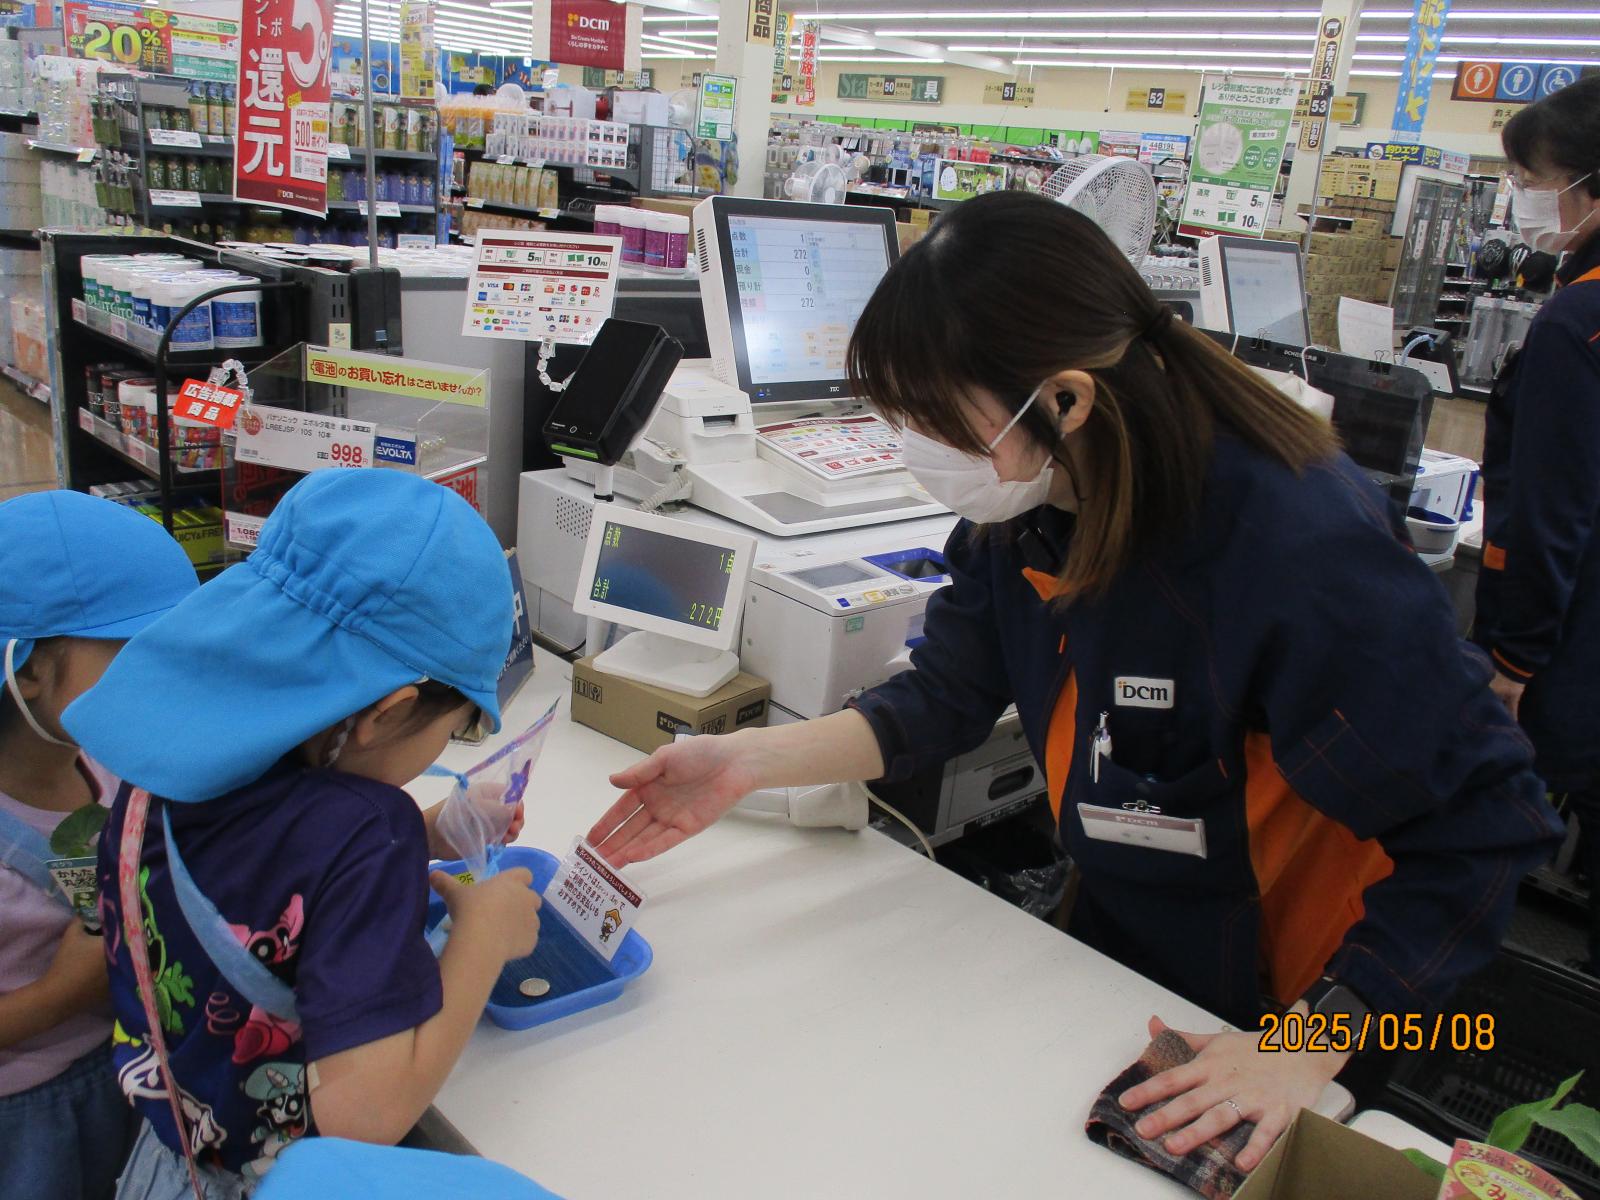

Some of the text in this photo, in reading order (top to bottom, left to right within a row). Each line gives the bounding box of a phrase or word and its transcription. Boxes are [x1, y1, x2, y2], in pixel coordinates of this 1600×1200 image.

[884, 81, 895, 92] 50
[1003, 86, 1015, 98] 51
[1149, 92, 1163, 104] 52
[244, 47, 285, 177] 還元
[1310, 99, 1327, 114] 53
[295, 120, 311, 147] 500
[731, 231, 747, 241] 点数
[793, 249, 808, 260] 272
[804, 266, 810, 275] 0
[807, 282, 813, 292] 0
[801, 298, 815, 308] 272
[184, 384, 239, 408] 広告掲載
[187, 402, 221, 421] 商品
[266, 413, 298, 425] パナソニック
[376, 445, 413, 461] EVOLTA
[604, 524, 621, 548] 点数
[593, 577, 610, 601] 合計
[689, 602, 724, 628] 272円
